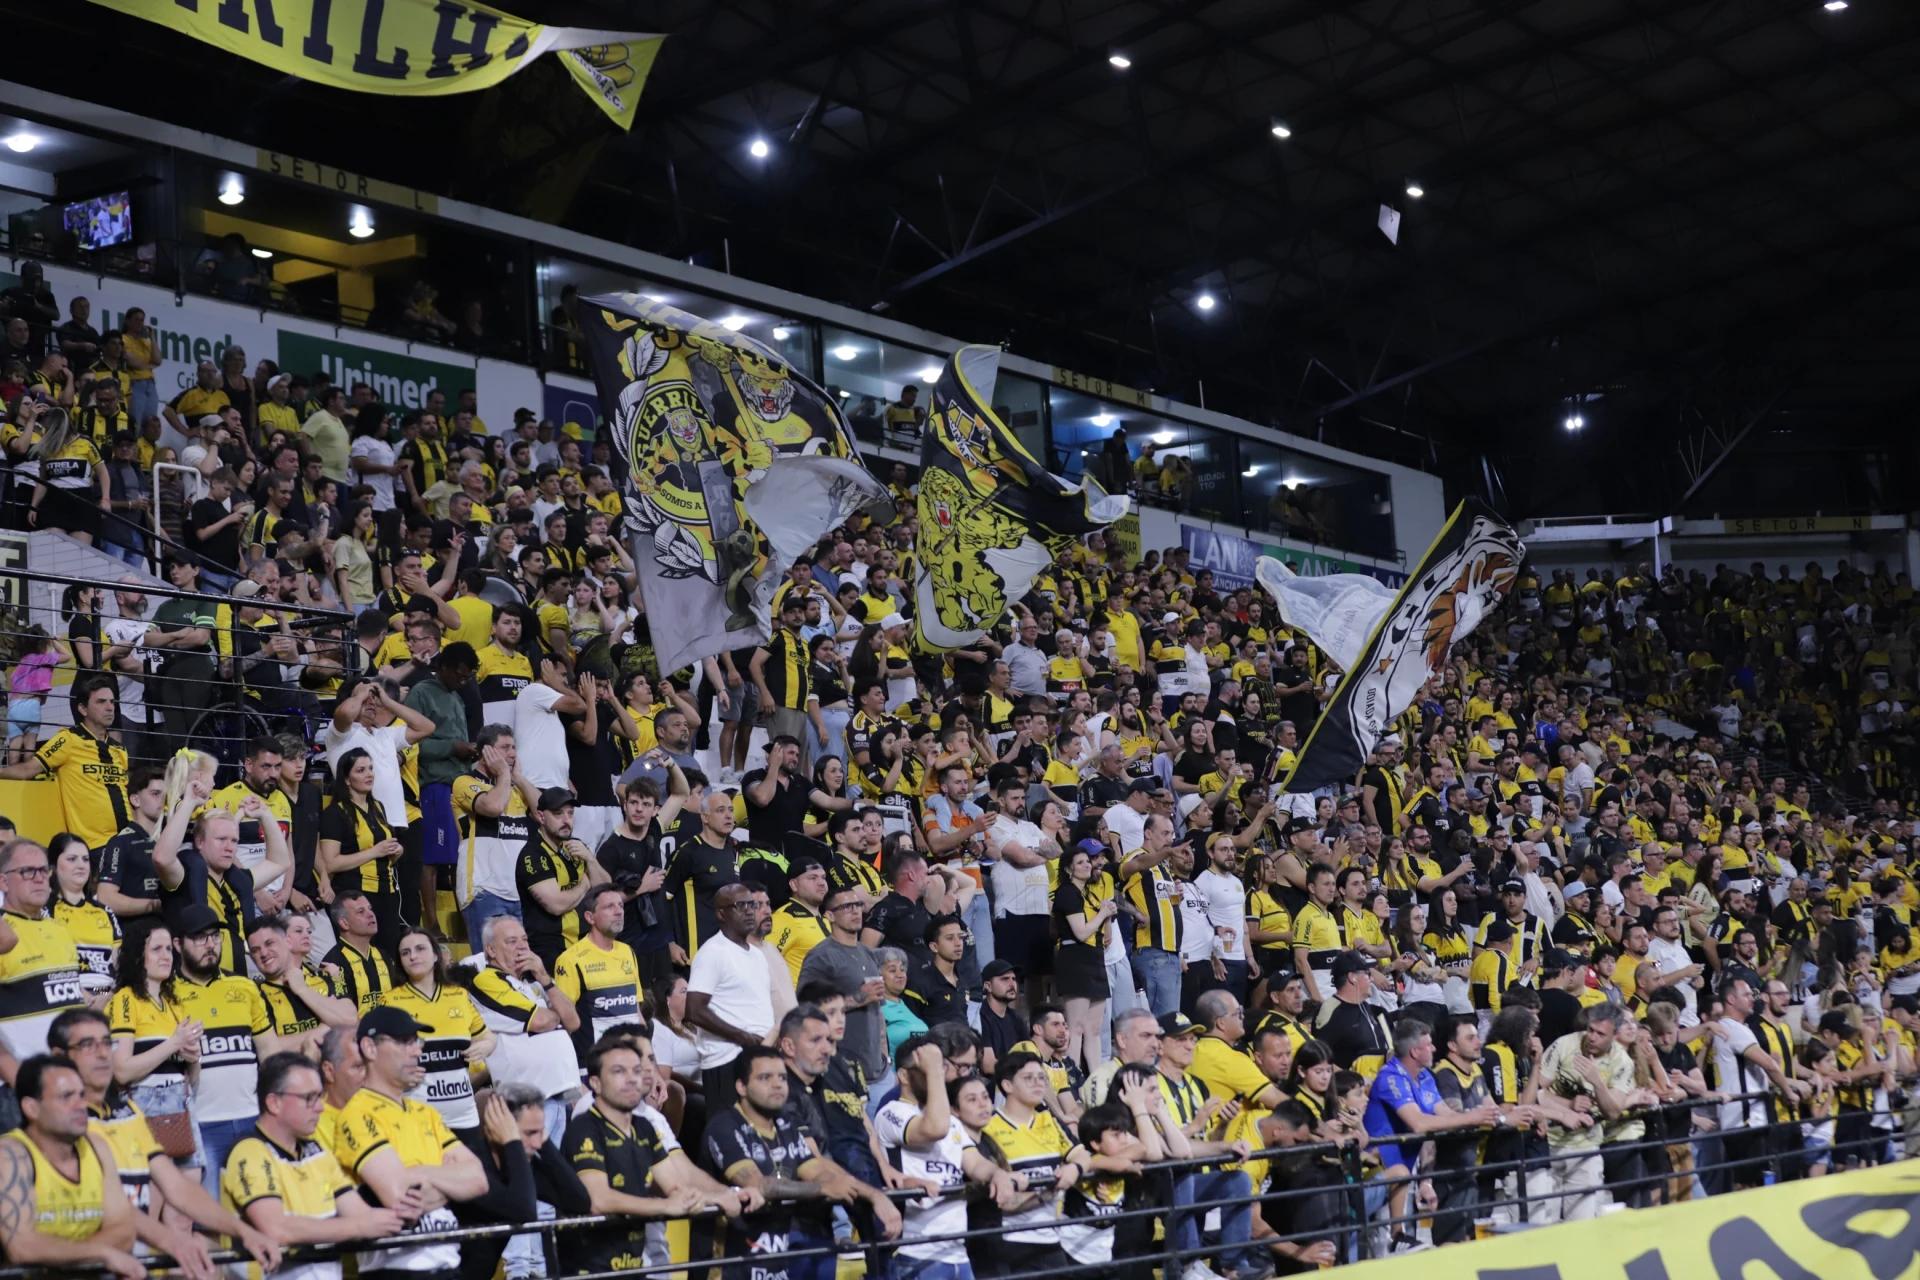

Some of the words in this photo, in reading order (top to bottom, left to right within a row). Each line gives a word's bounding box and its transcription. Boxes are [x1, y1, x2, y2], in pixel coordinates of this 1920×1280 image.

[270, 153, 368, 196] SETOR
[414, 191, 424, 210] L
[102, 309, 233, 366] Uimed
[321, 354, 437, 410] Unimed
[1060, 369, 1112, 399] SETOR
[1136, 391, 1145, 405] M
[660, 487, 693, 510] SOMOS
[1736, 518, 1816, 532] SETOR
[1852, 517, 1862, 529] N
[1189, 531, 1238, 574] LAN
[594, 994, 637, 1011] Spring
